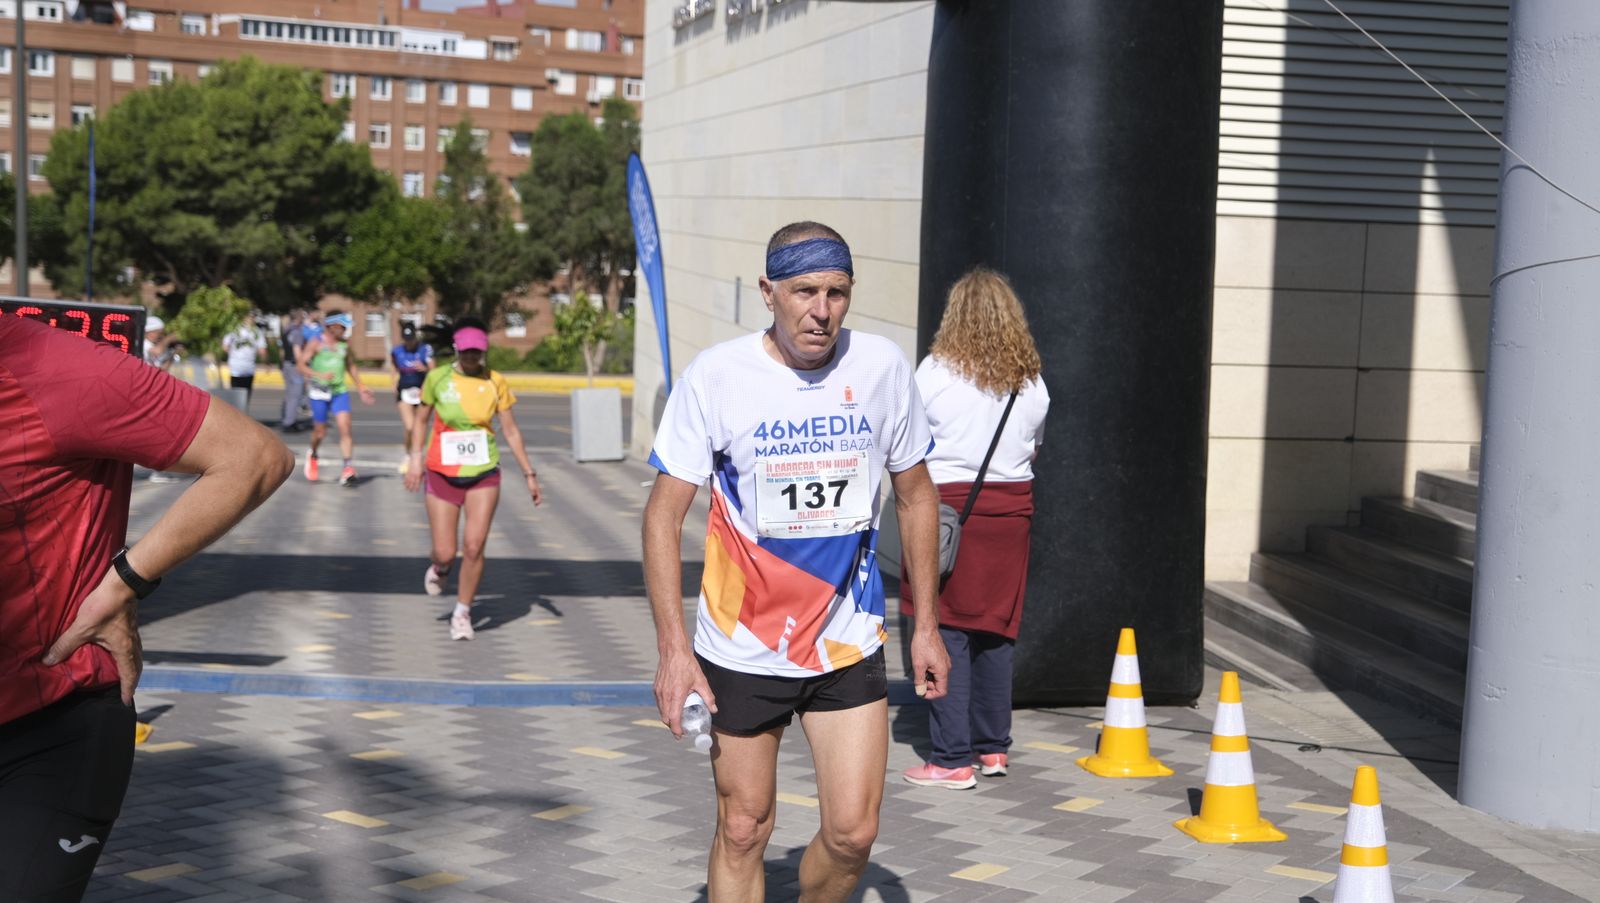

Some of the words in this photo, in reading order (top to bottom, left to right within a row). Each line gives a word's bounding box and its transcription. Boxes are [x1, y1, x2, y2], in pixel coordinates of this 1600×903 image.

[456, 442, 476, 455] 90
[755, 439, 834, 457] MARATÓN
[840, 438, 874, 452] BAZA
[816, 460, 832, 469] SIN
[834, 458, 858, 468] HUMO
[781, 480, 848, 510] 137
